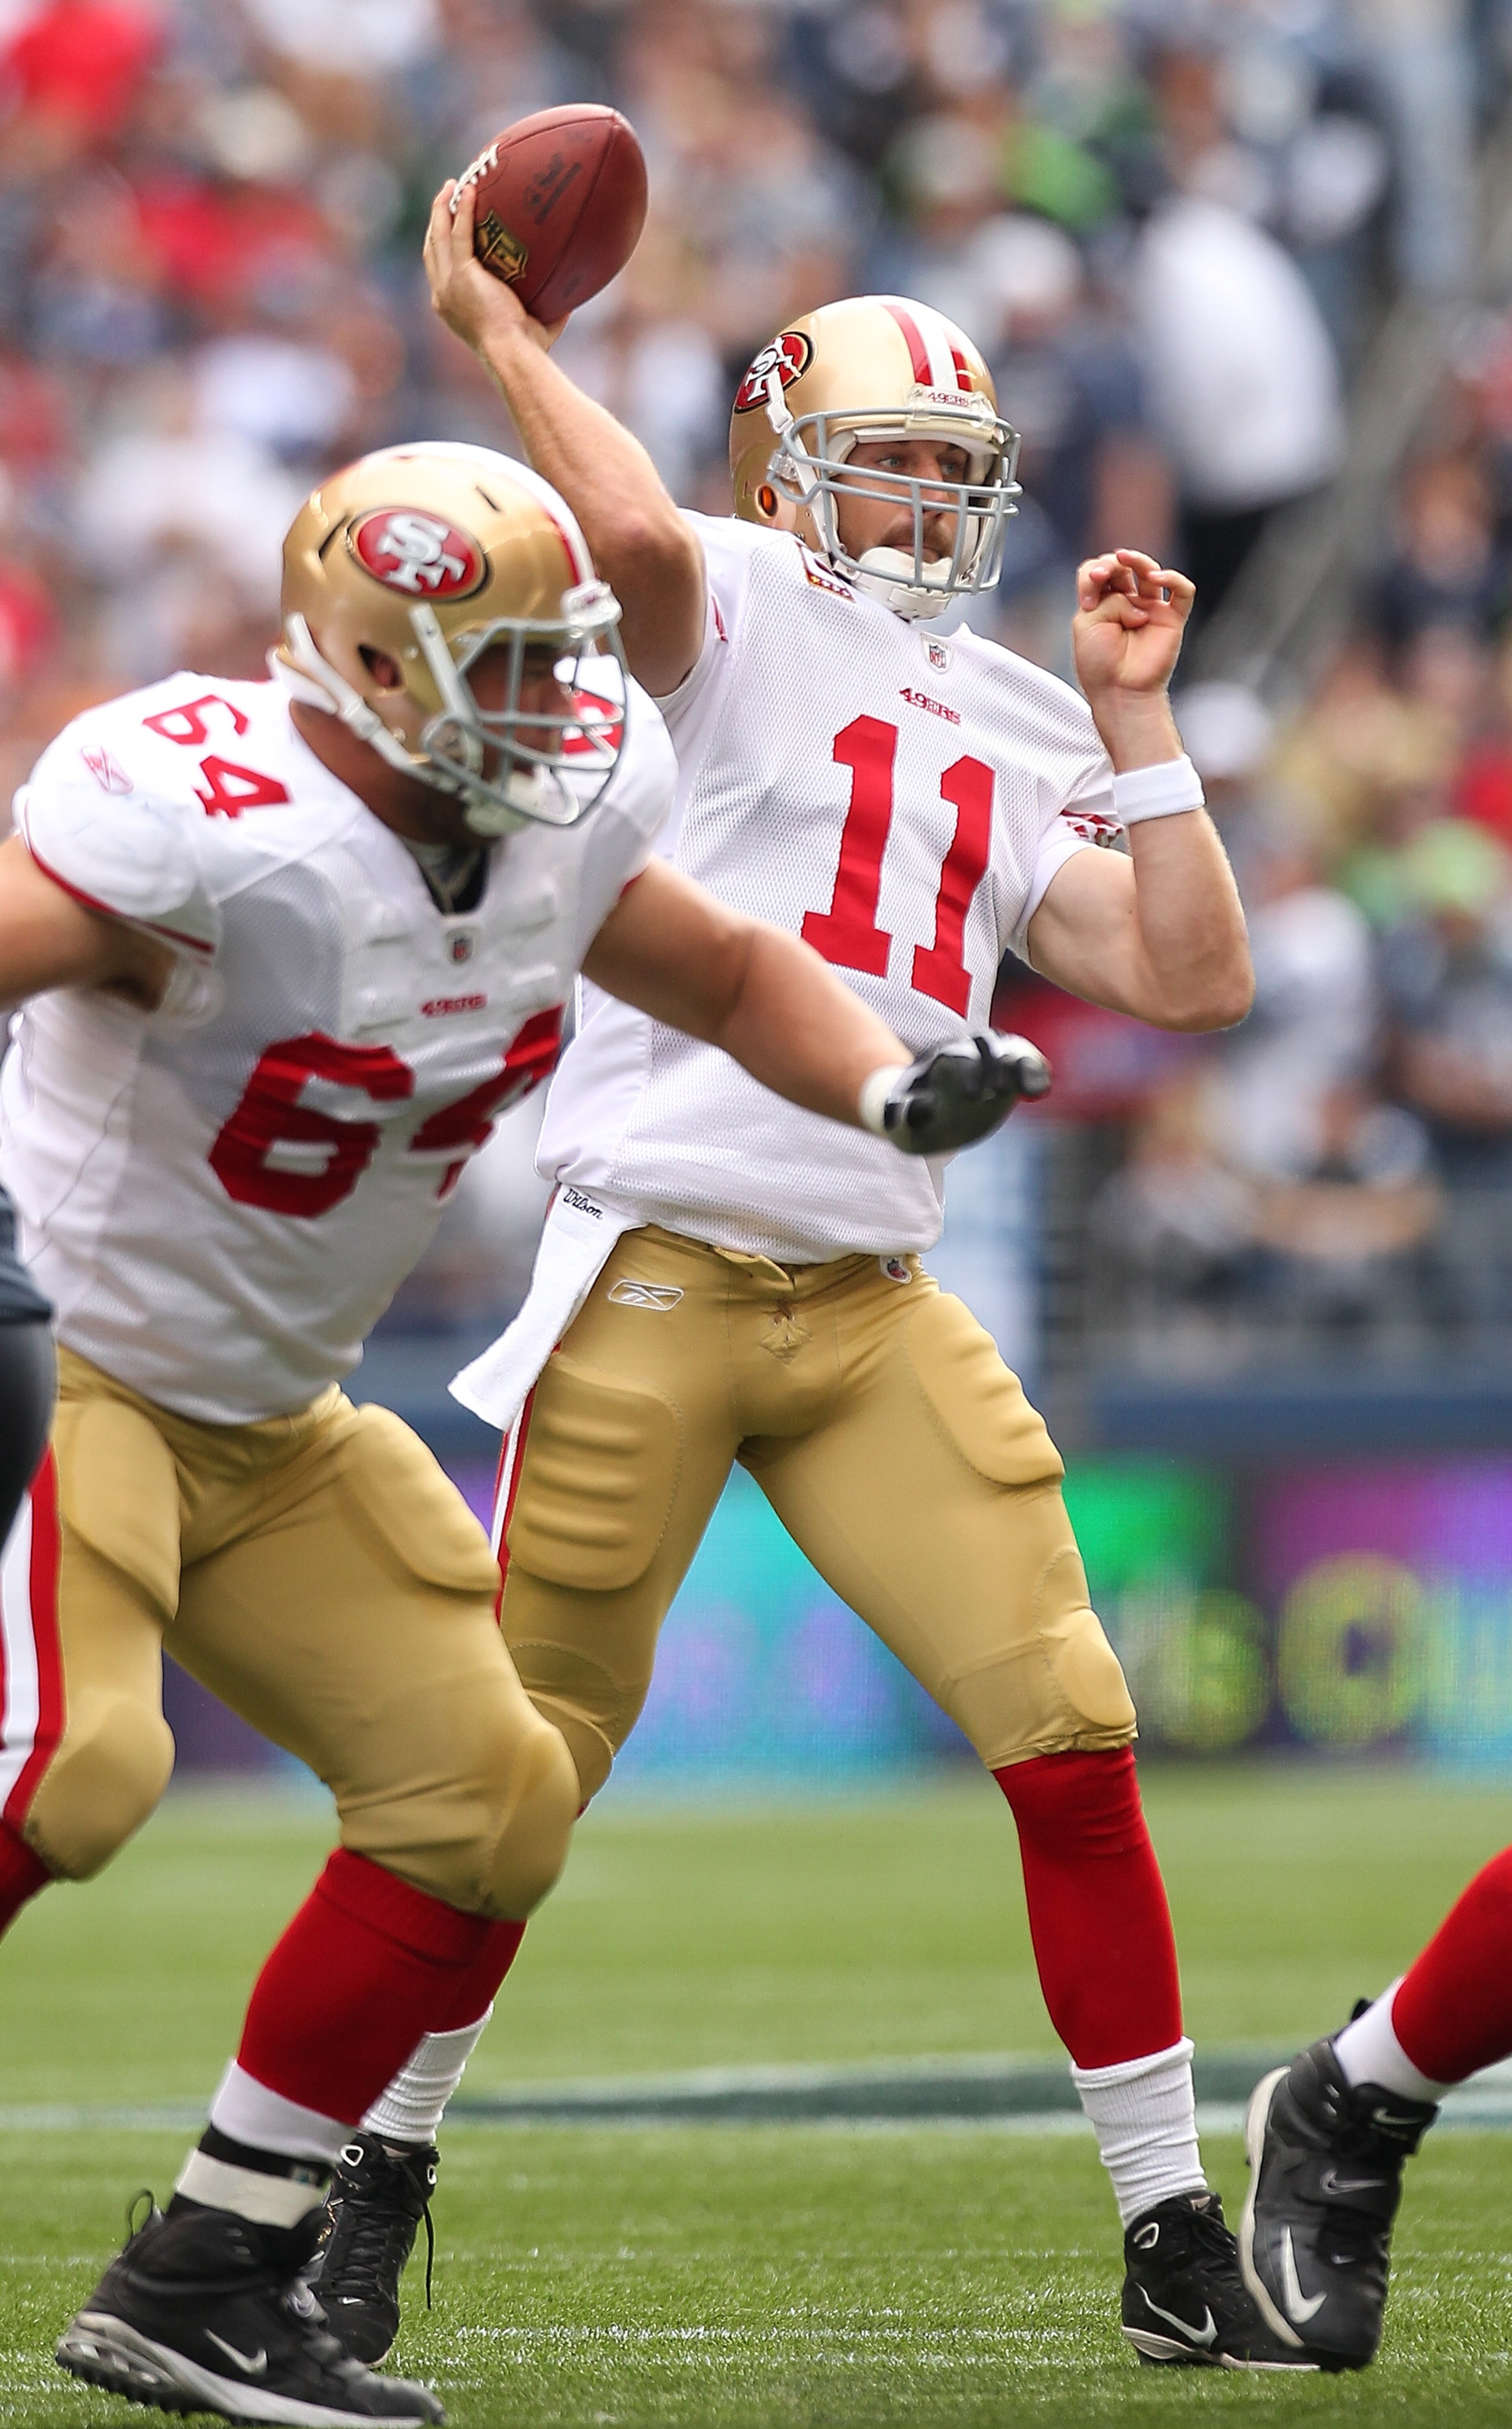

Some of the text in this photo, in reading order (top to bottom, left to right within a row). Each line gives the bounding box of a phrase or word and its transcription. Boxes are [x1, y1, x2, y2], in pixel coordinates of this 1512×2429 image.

[928, 392, 969, 407] 49ERS
[899, 687, 961, 725] 49ERS
[142, 694, 289, 818] 64
[801, 714, 995, 1019] 11
[208, 1003, 567, 1219] 64
[563, 1188, 604, 1220] Wilson
